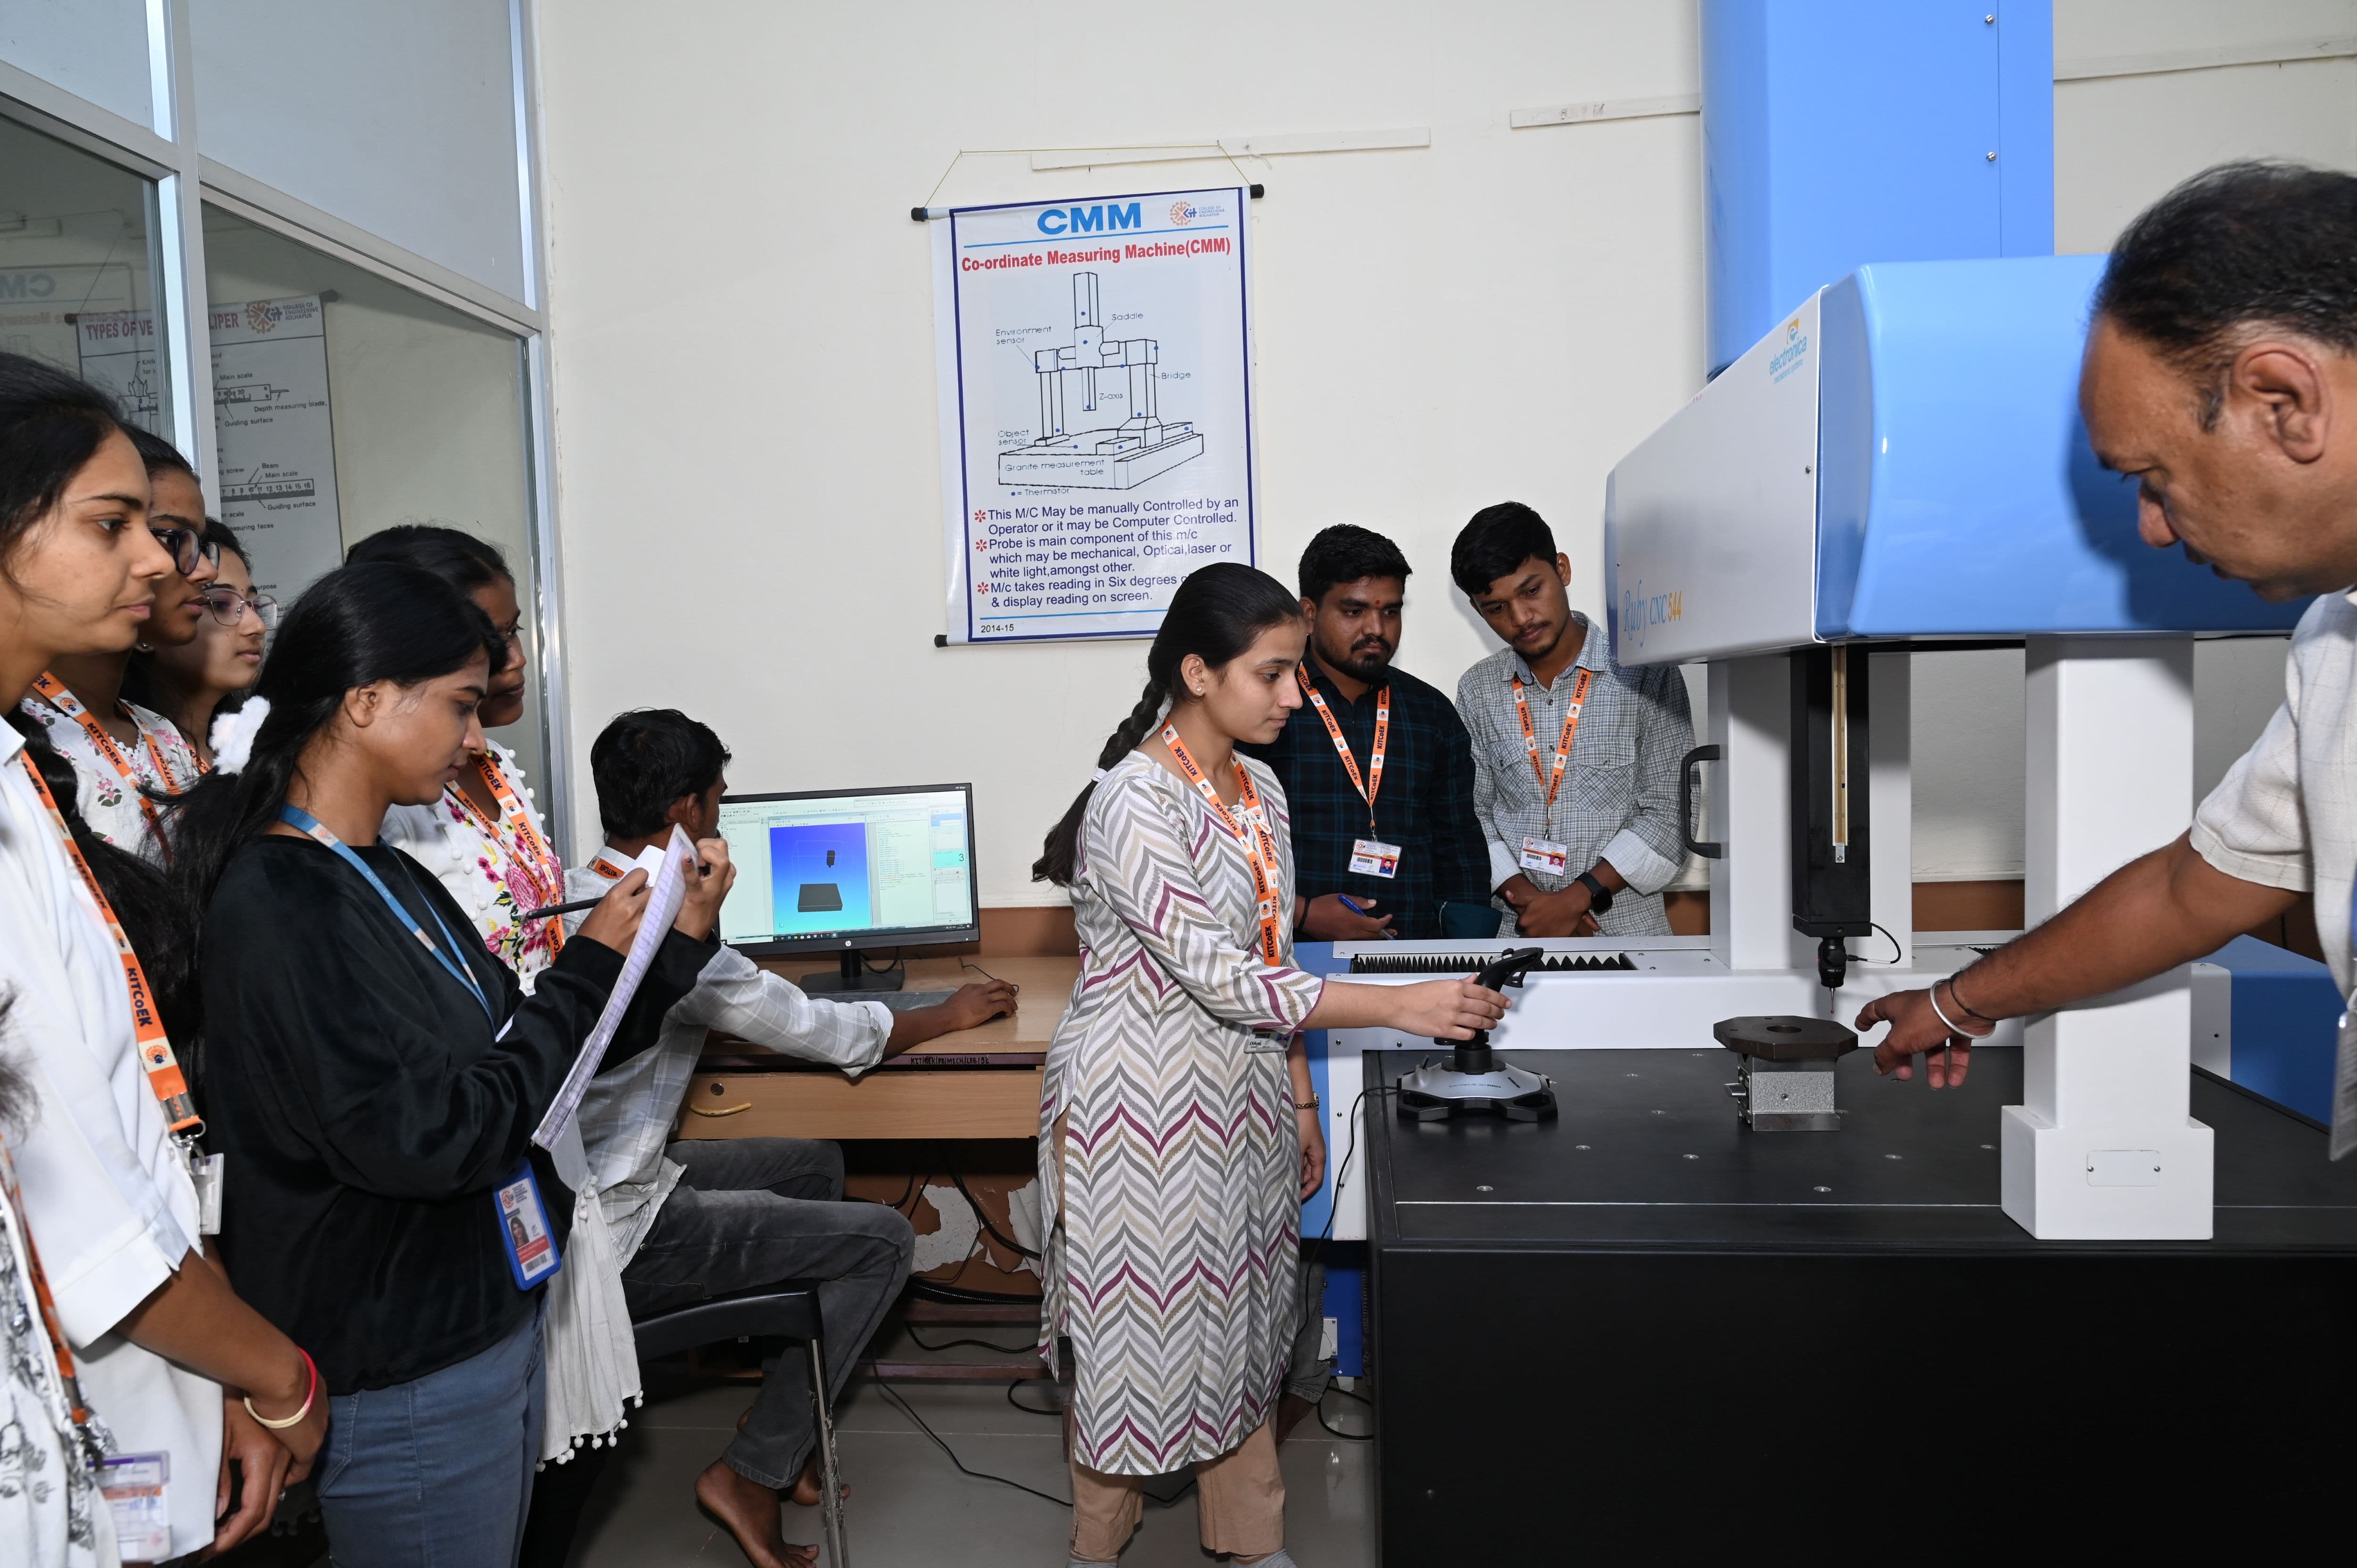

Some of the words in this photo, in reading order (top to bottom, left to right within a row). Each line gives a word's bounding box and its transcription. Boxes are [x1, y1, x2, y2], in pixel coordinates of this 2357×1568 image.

[1037, 203, 1141, 235] CMM
[962, 253, 1043, 271] Co-ordinate
[1047, 246, 1121, 265] Measuring
[1125, 238, 1231, 259] Machine(CMM)
[285, 306, 319, 315] ENGINEERING
[1112, 312, 1144, 321] Saddle
[209, 312, 239, 329] LIPER
[86, 323, 119, 340] TYPES
[122, 321, 136, 337] OF
[996, 326, 1052, 337] Environment
[996, 337, 1025, 345] sensor
[1770, 336, 1807, 376] electronica
[1161, 371, 1191, 380] Bridge
[275, 402, 306, 410] measuring
[998, 429, 1030, 438] Object
[1005, 461, 1038, 471] Granite
[1041, 459, 1104, 469] measurement
[1024, 487, 1070, 496] Thermistor
[988, 509, 1012, 520] This
[1015, 507, 1038, 518] M/C
[1042, 506, 1066, 518] May
[1070, 505, 1084, 515] be
[1088, 502, 1139, 515] manually
[1143, 499, 1203, 511] Controlled
[1207, 498, 1220, 510] by
[1224, 499, 1238, 508] an
[989, 523, 1038, 537] Operator
[1042, 524, 1054, 532] or
[1057, 521, 1063, 531] it
[1067, 521, 1091, 532] may
[1095, 519, 1109, 529] be
[1113, 516, 1170, 529] Computer
[1174, 512, 1236, 525] Controlled.
[989, 538, 1023, 550] Probe
[1027, 537, 1035, 547] is
[1039, 535, 1066, 546] main
[1071, 532, 1134, 546] component
[1137, 531, 1149, 541] of
[1152, 530, 1172, 541] this
[1177, 528, 1198, 539] m/c
[990, 552, 1022, 564] which
[1026, 552, 1049, 563] may
[1053, 550, 1067, 560] be
[1071, 546, 1139, 559] mechanical,
[1220, 544, 1232, 552] or
[990, 567, 1020, 578] white
[1103, 562, 1135, 573] other.
[991, 583, 1012, 593] M/c
[1015, 581, 1045, 591] takes
[1049, 578, 1091, 590] reading
[1095, 577, 1104, 588] in
[1108, 576, 1126, 587] Six
[1129, 575, 1177, 588] degrees
[991, 597, 1000, 607] &
[1003, 595, 1043, 608] display
[1047, 593, 1089, 606] reading
[1092, 594, 1106, 603] on
[1110, 592, 1153, 602] screen.
[1624, 579, 1647, 648] Ruby
[1650, 594, 1667, 625] CNC
[1668, 590, 1682, 622] 544
[981, 624, 1014, 633] 2014-15
[958, 853, 964, 862] 3
